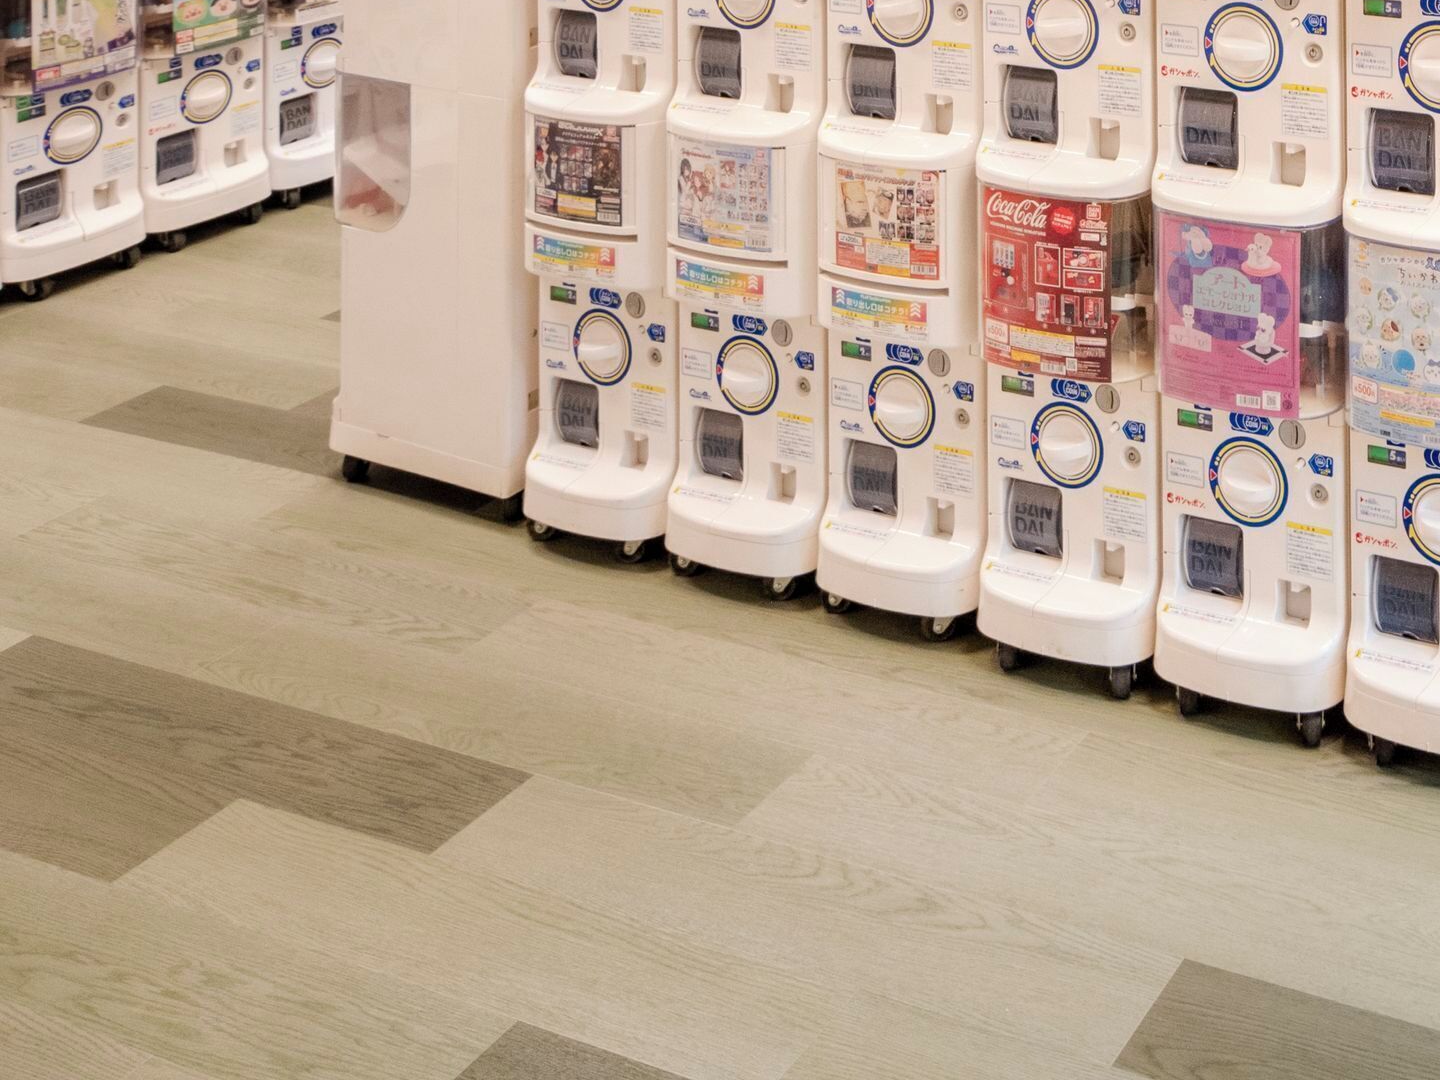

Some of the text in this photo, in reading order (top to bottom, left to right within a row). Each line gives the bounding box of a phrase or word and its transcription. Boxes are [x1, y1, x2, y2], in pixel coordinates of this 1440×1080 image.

[1360, 88, 1393, 99] ガシャポン
[987, 192, 1051, 228] Coca-Cola
[1211, 273, 1246, 289] アート
[1363, 534, 1398, 550] ガシャポン
